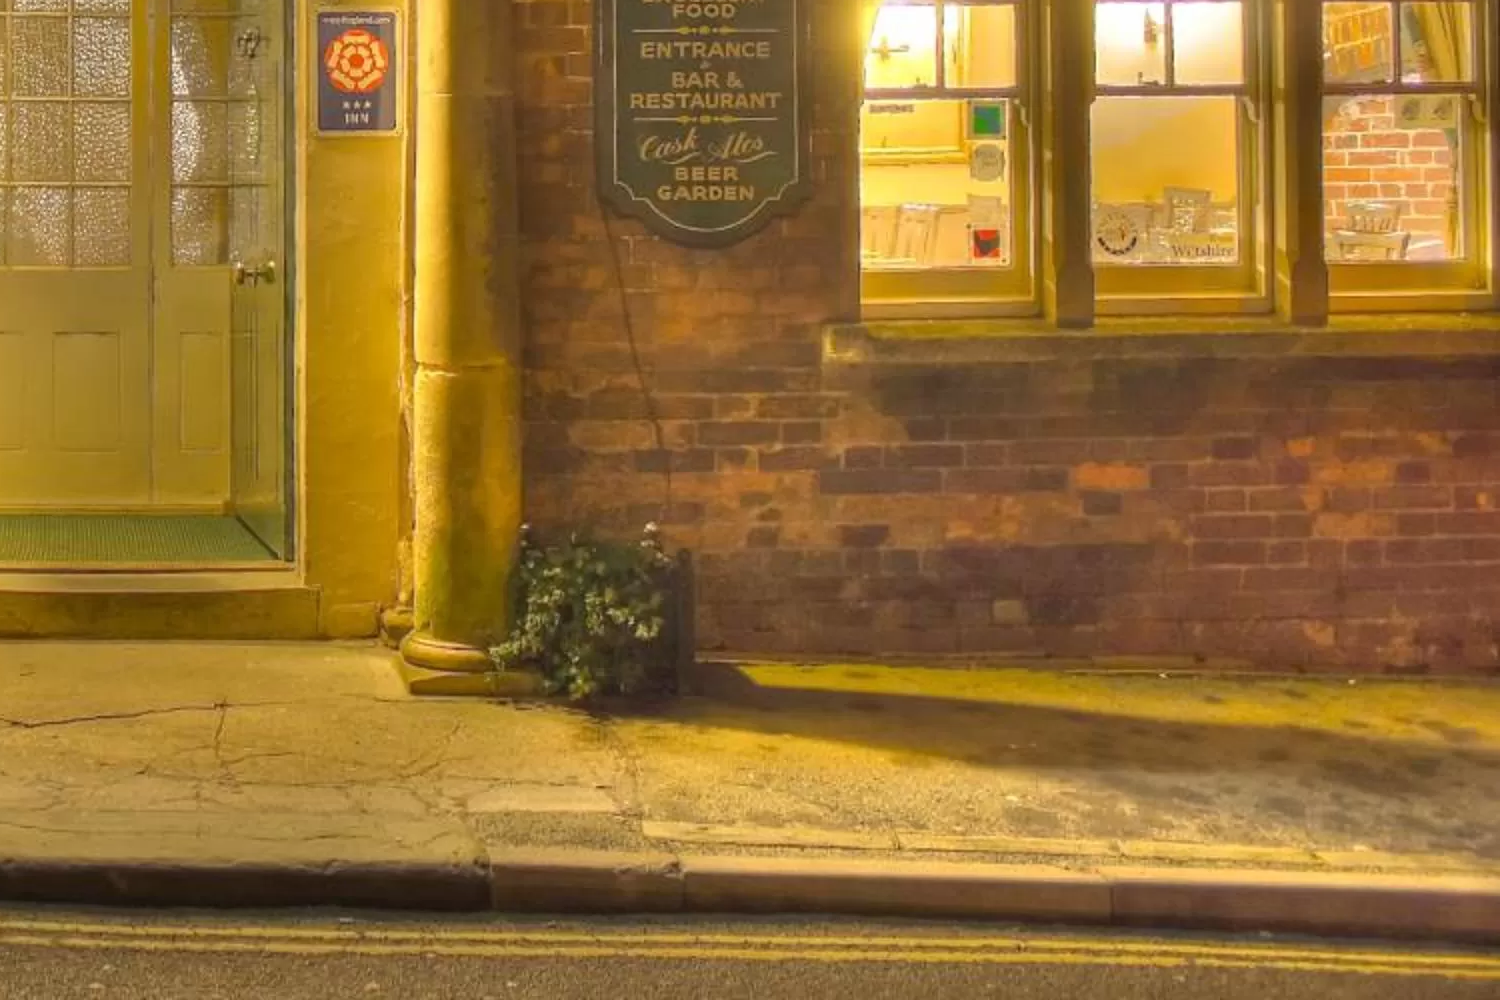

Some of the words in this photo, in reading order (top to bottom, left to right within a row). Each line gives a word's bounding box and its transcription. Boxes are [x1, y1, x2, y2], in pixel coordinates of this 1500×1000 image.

[672, 3, 736, 18] FOOD
[640, 41, 771, 58] ENTRANCE
[671, 72, 720, 89] BAR
[727, 72, 744, 89] &
[630, 92, 782, 109] RESTAURANT
[344, 112, 369, 124] INN
[639, 126, 699, 162] Cask
[708, 131, 772, 162] Ales
[675, 166, 738, 181] BEER
[657, 185, 755, 201] GARDEN
